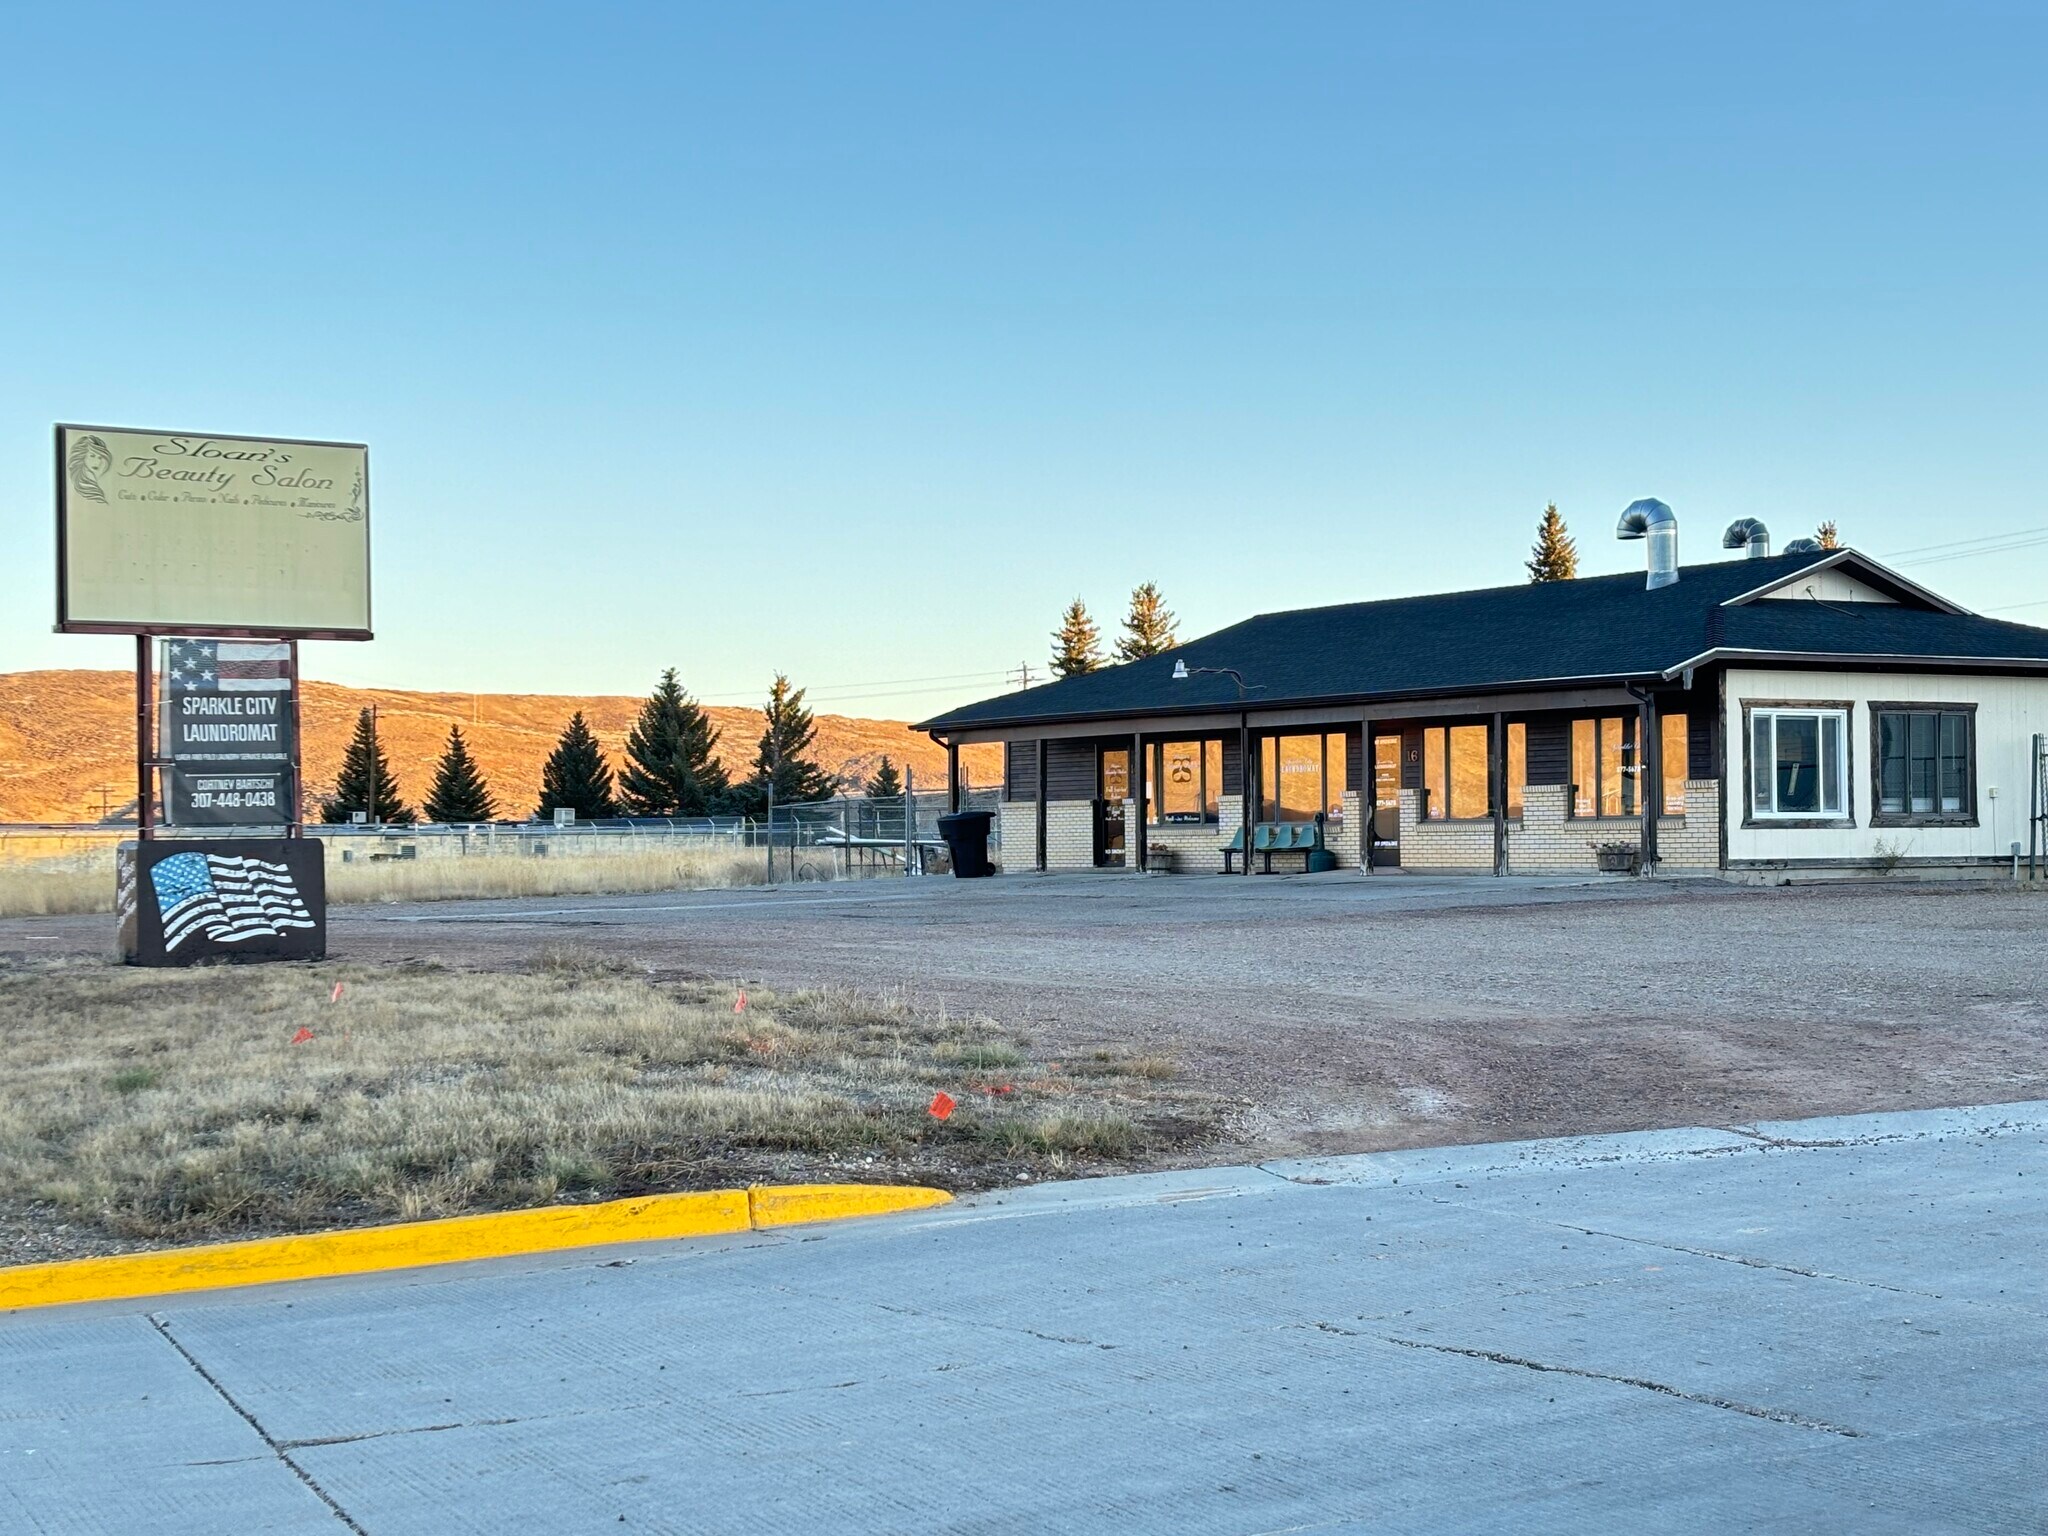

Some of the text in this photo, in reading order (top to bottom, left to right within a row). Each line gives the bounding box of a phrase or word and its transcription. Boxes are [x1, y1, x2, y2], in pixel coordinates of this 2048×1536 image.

[153, 438, 293, 464] Sloan's
[117, 457, 334, 492] Beauty Salon
[219, 493, 240, 504] Nails
[182, 697, 277, 716] SPARKLE CITY
[183, 723, 278, 742] LAUNDROMAT
[1407, 750, 1418, 762] 16
[190, 791, 276, 808] 307-448-0438
